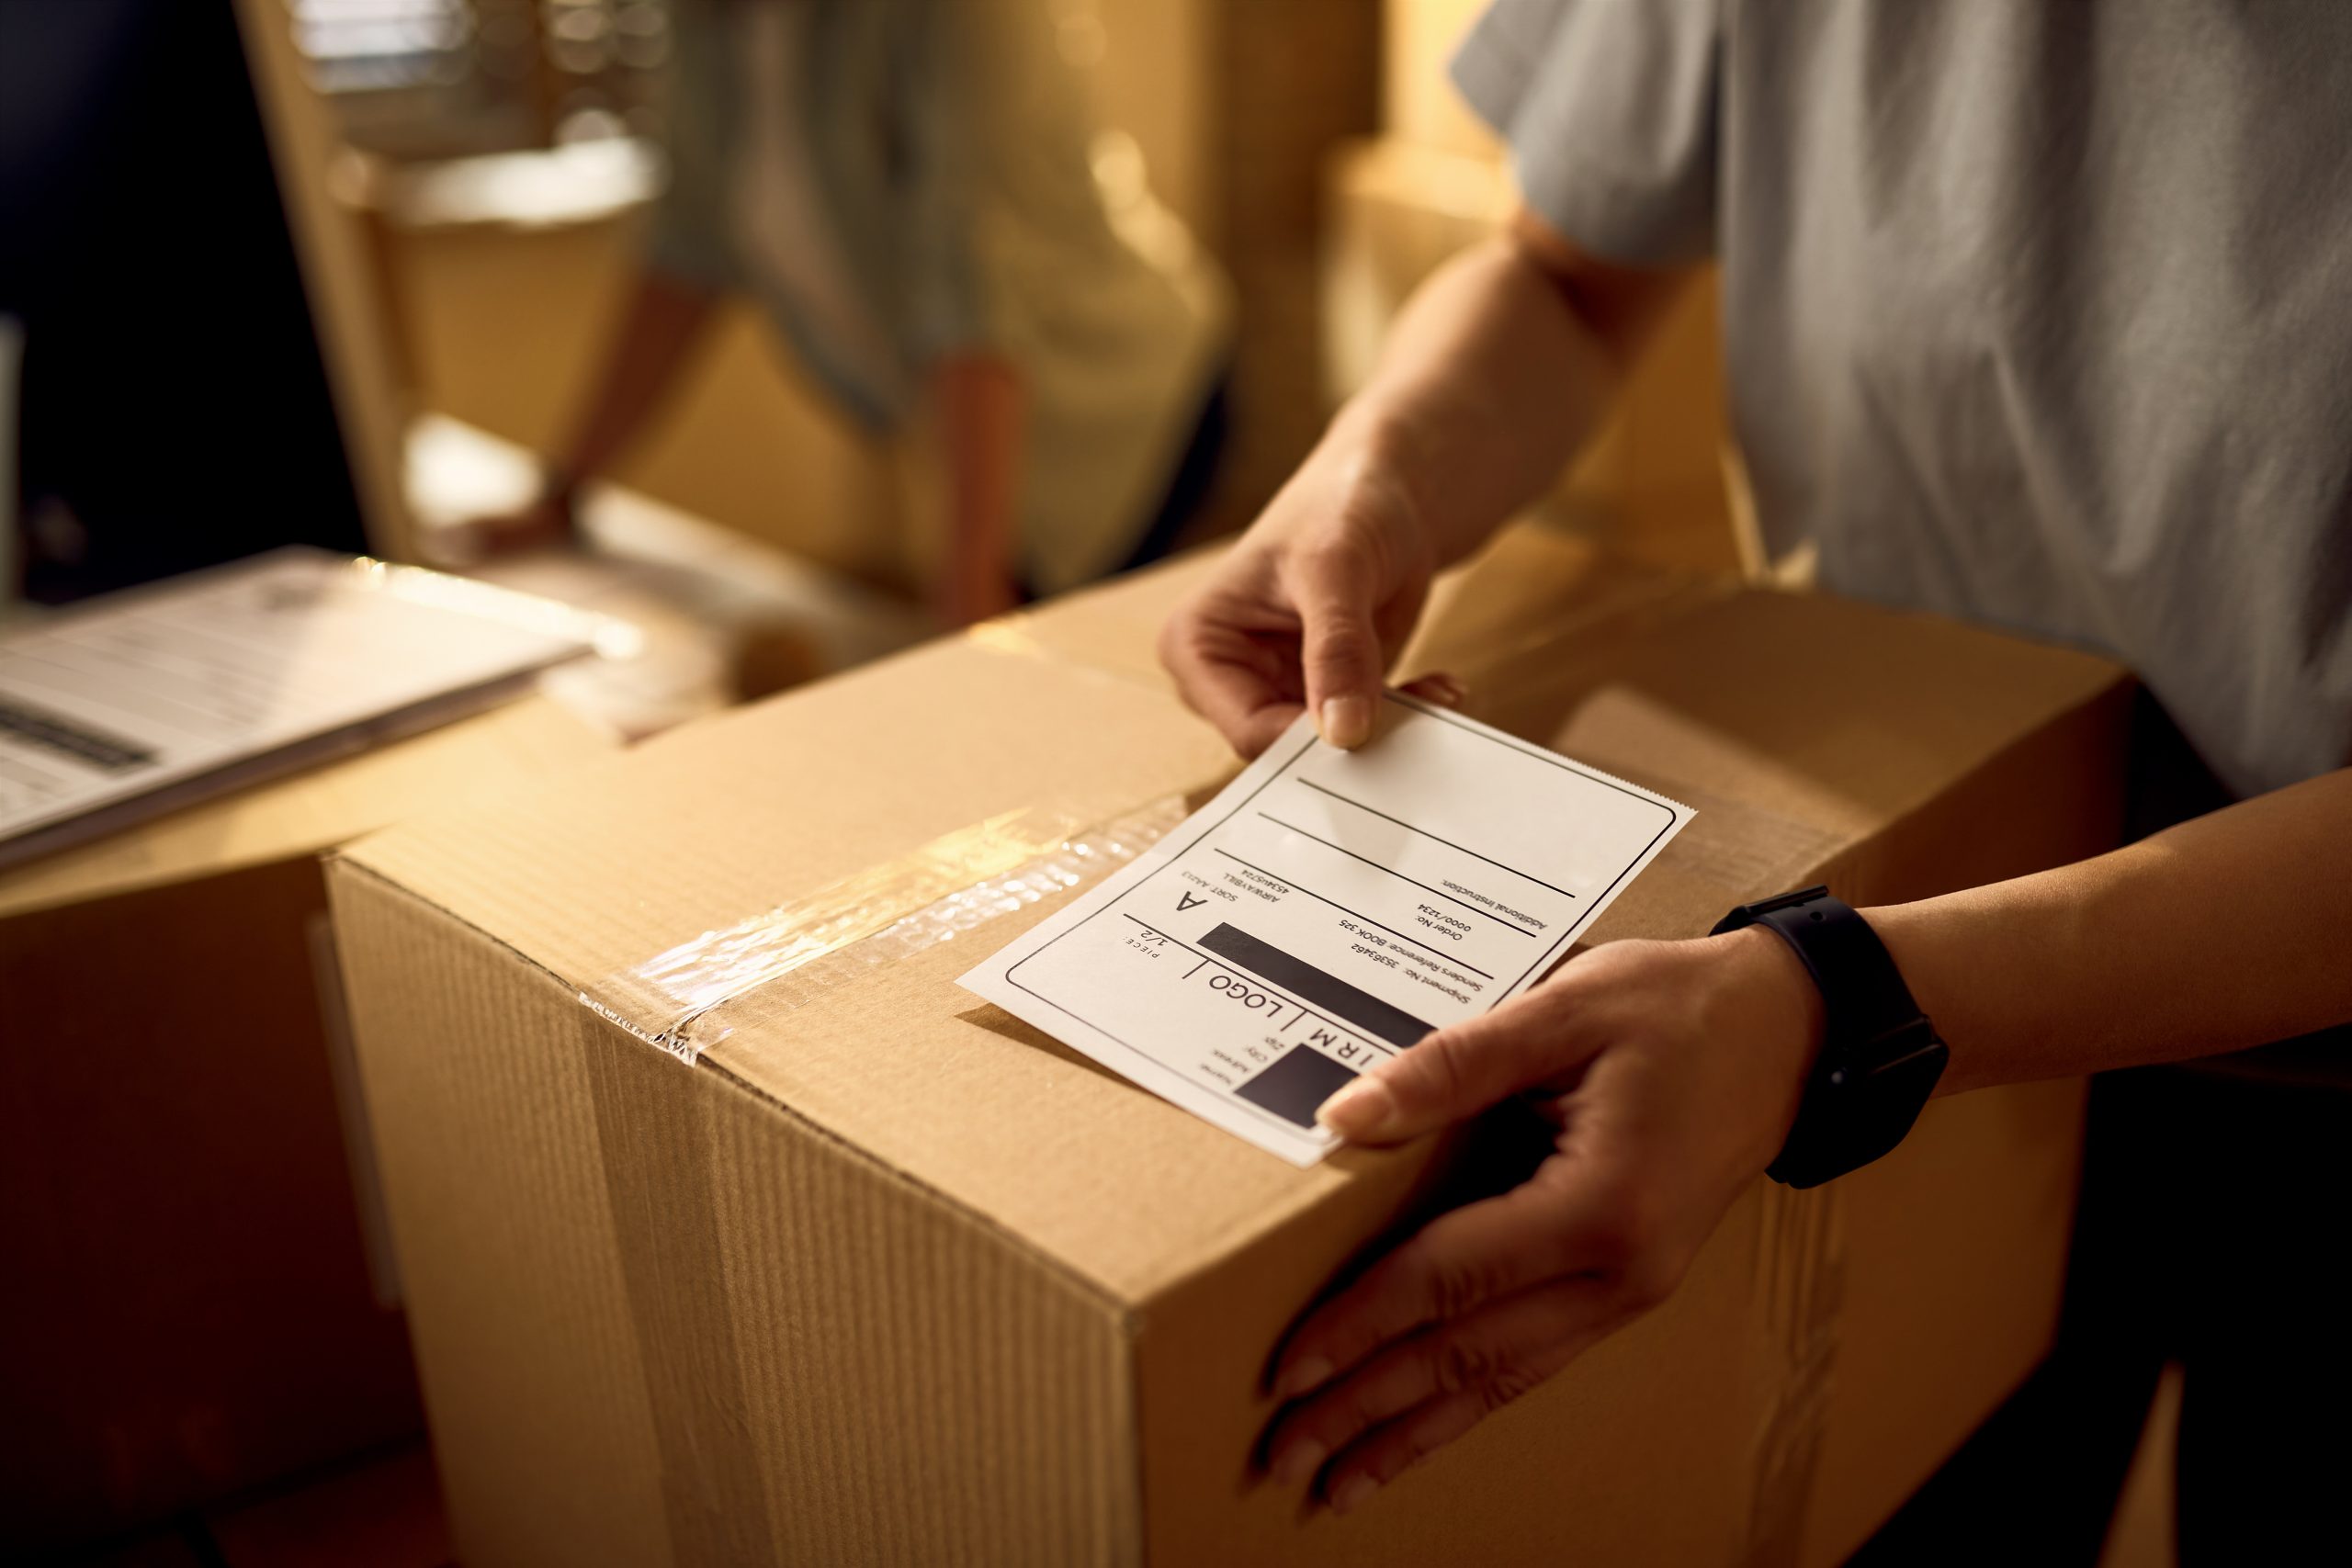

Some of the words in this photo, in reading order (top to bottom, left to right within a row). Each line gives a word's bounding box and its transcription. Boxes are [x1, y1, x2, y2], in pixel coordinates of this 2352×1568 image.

[1223, 873, 1281, 903] AIRWAYBILL
[1441, 879, 1496, 908] Instruction:
[1176, 891, 1208, 911] A
[1339, 919, 1359, 931] 325
[1415, 915, 1433, 928] No:
[1417, 903, 1472, 932] 0000/1234
[1495, 903, 1548, 931] Additional
[1140, 930, 1169, 947] 1/2
[1355, 929, 1387, 947] BOOK
[1433, 923, 1463, 941] Order
[1122, 936, 1160, 958] PIECE:
[1351, 943, 1400, 968] 35363462
[1387, 942, 1441, 972] Reference:
[1420, 976, 1472, 1004] Shipment
[1441, 967, 1484, 992] Senders
[1209, 975, 1283, 1018] LOGO
[1309, 1028, 1374, 1066] IRM
